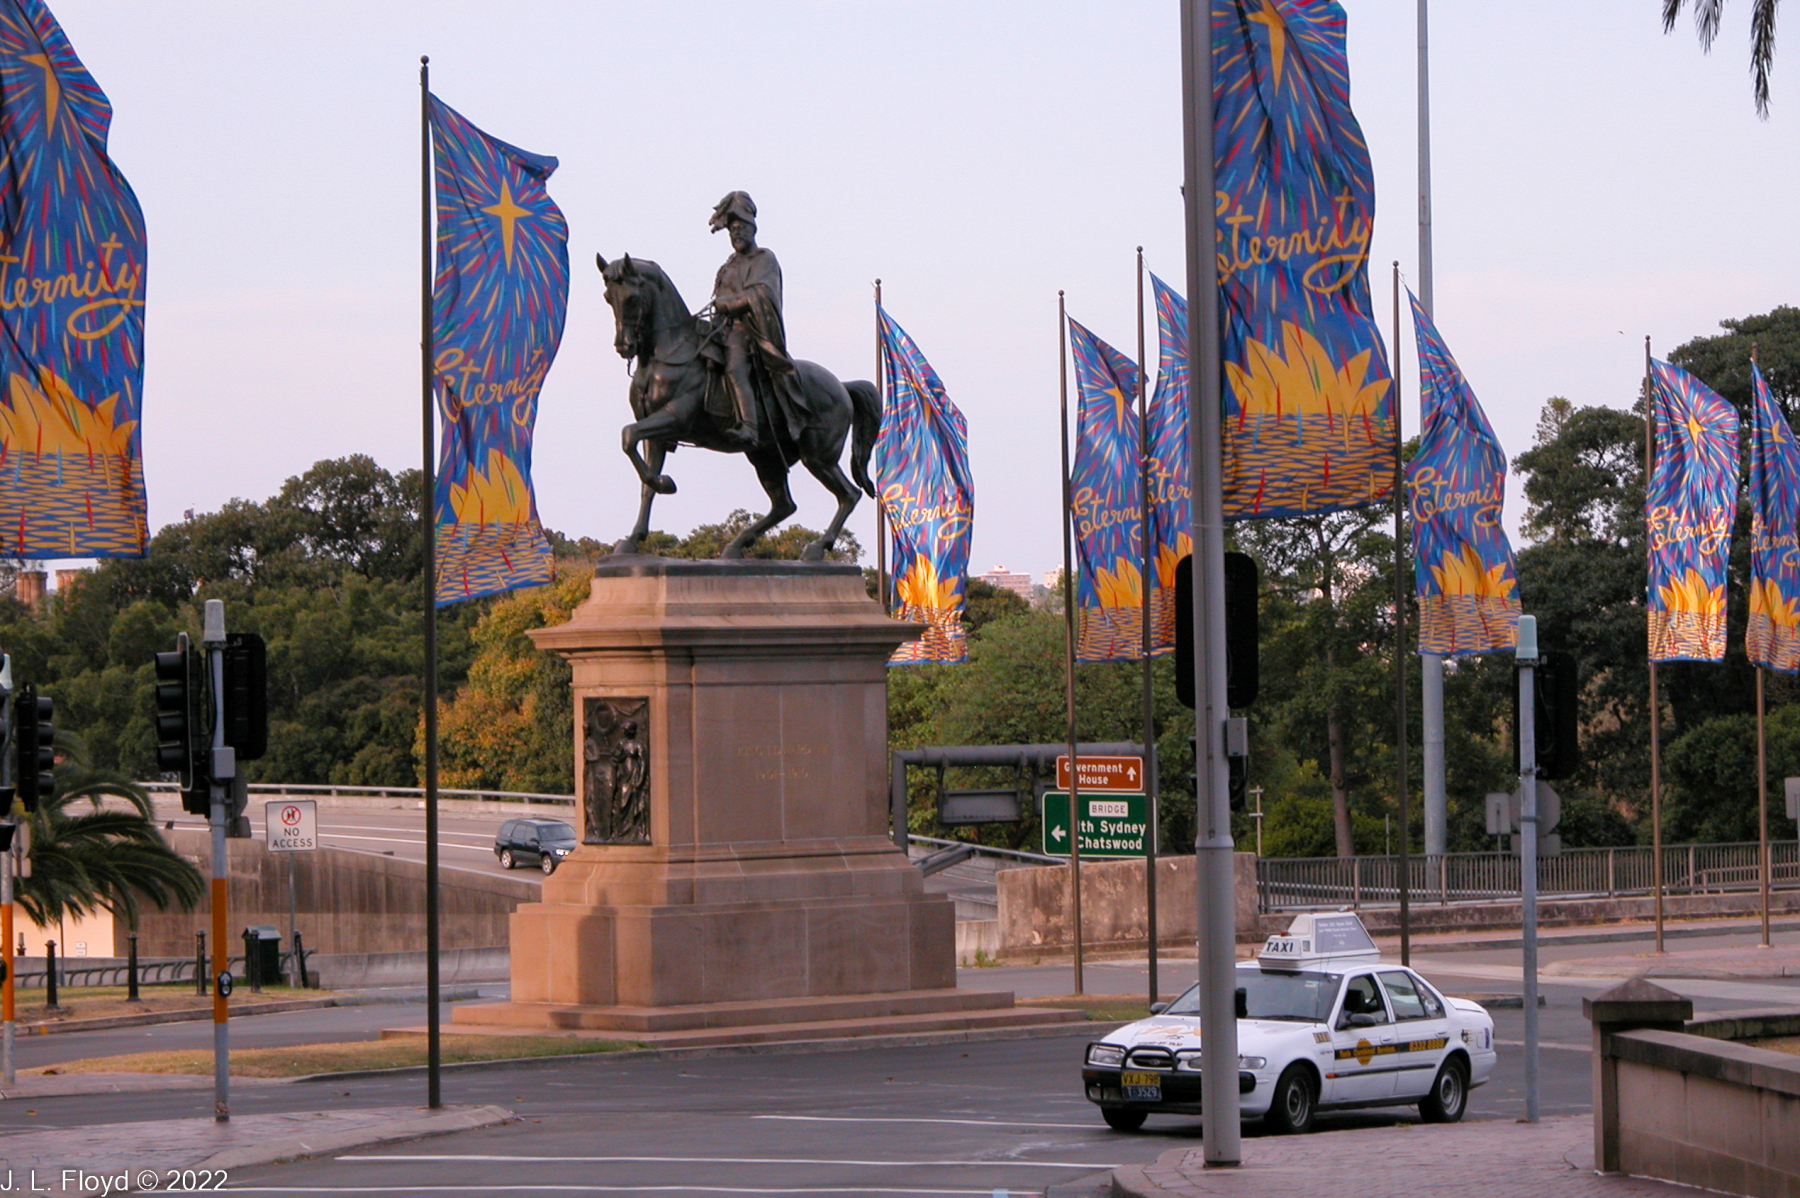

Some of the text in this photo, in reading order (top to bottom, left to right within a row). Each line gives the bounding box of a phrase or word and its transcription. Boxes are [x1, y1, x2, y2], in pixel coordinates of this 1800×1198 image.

[0, 232, 145, 339] ternity
[1064, 762, 1123, 774] Gvernment
[1079, 774, 1109, 785] House
[1092, 804, 1126, 814] BRIDGE
[284, 827, 300, 837] NO
[1078, 820, 1146, 837] th Sydney
[272, 838, 313, 848] ACCESS
[1266, 942, 1294, 953] TAXI
